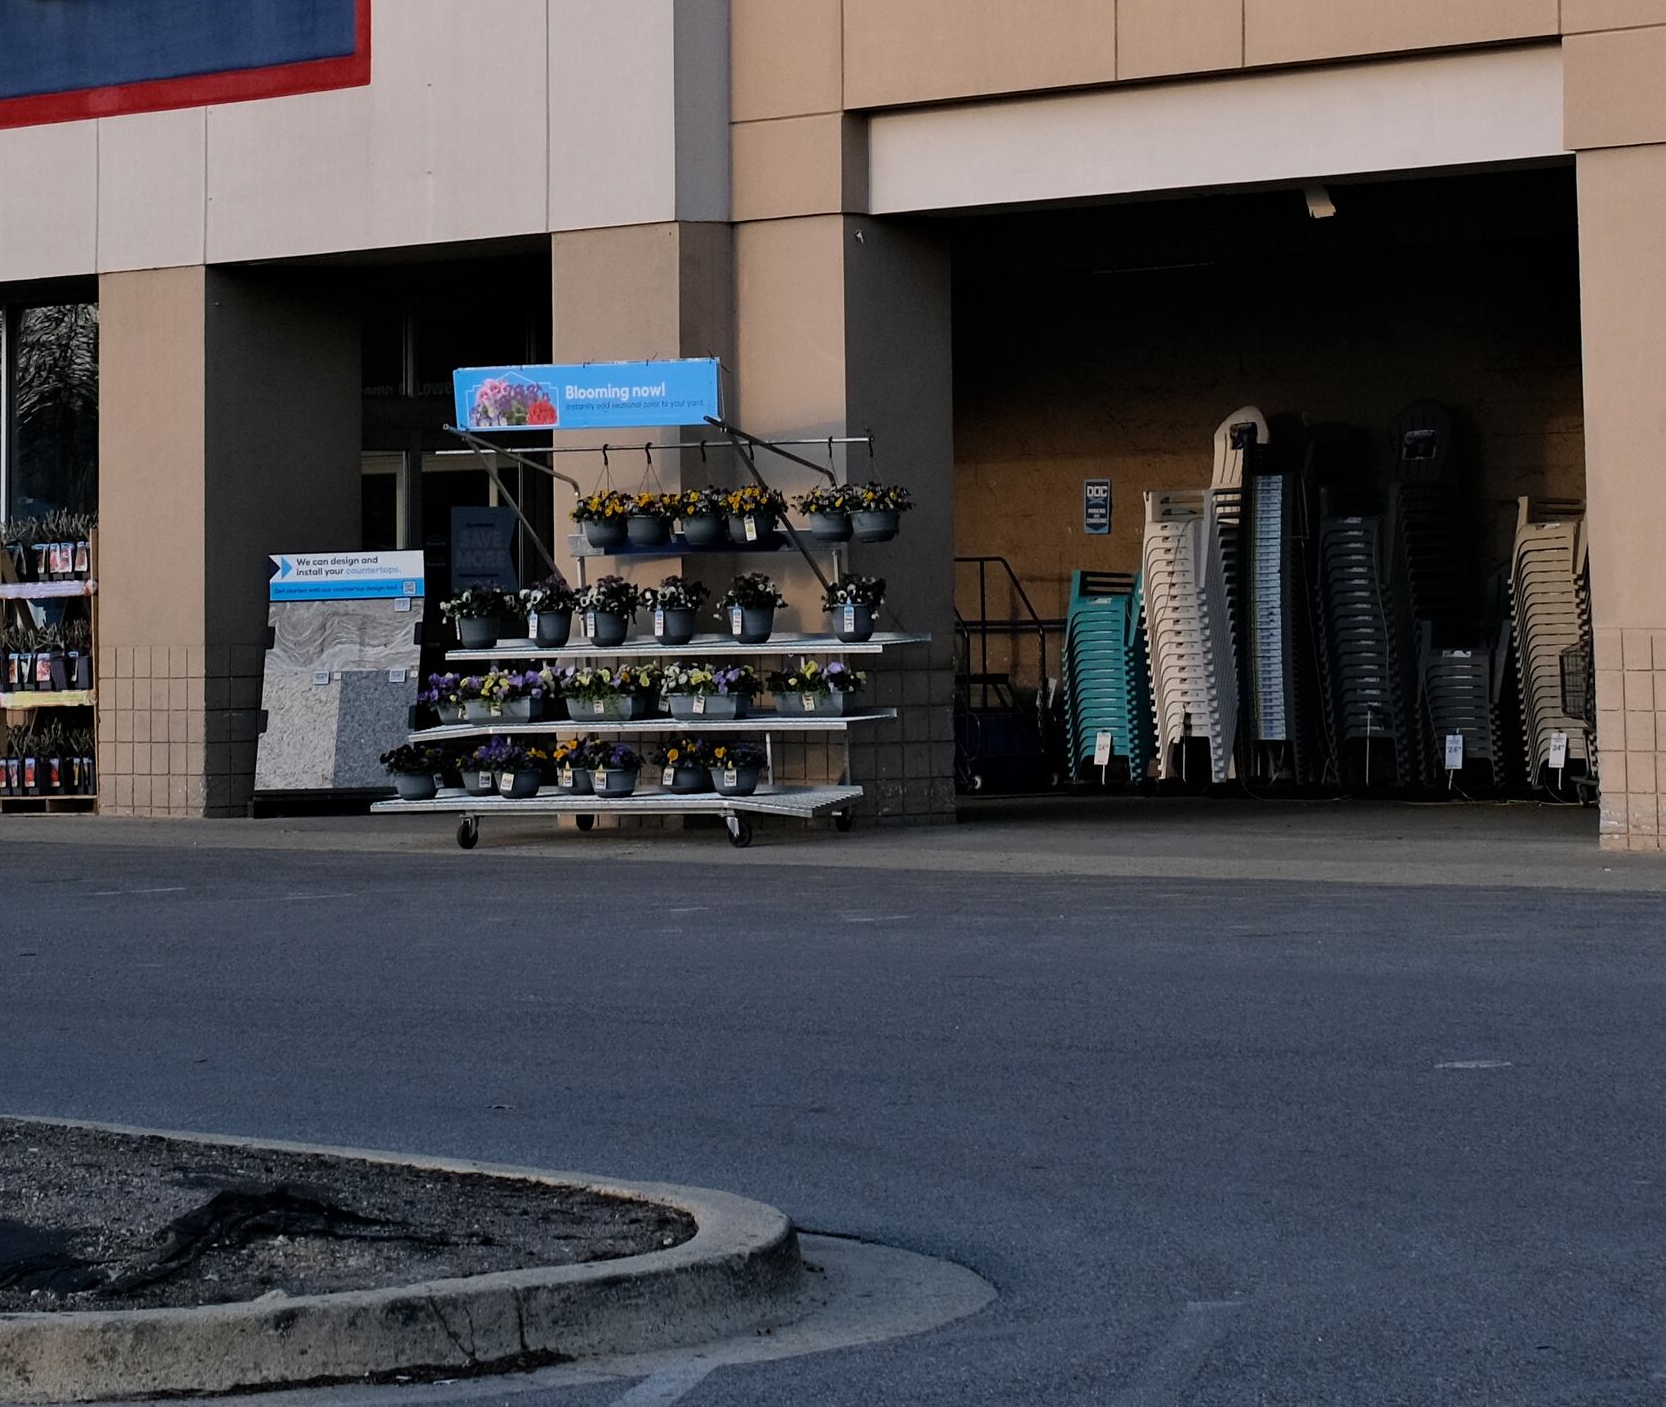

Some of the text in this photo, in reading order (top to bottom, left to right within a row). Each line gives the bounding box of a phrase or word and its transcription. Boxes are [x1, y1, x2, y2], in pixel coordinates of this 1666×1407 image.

[565, 381, 666, 401] Blooming now!
[566, 402, 594, 411] Instantly
[596, 401, 611, 410] add
[643, 400, 660, 408] color
[670, 400, 686, 409] your
[461, 530, 502, 547] SAVE
[296, 557, 311, 566] We
[331, 556, 360, 567] design
[362, 555, 378, 564] and
[457, 550, 507, 569] MORE
[296, 566, 402, 577] install your countertops.
